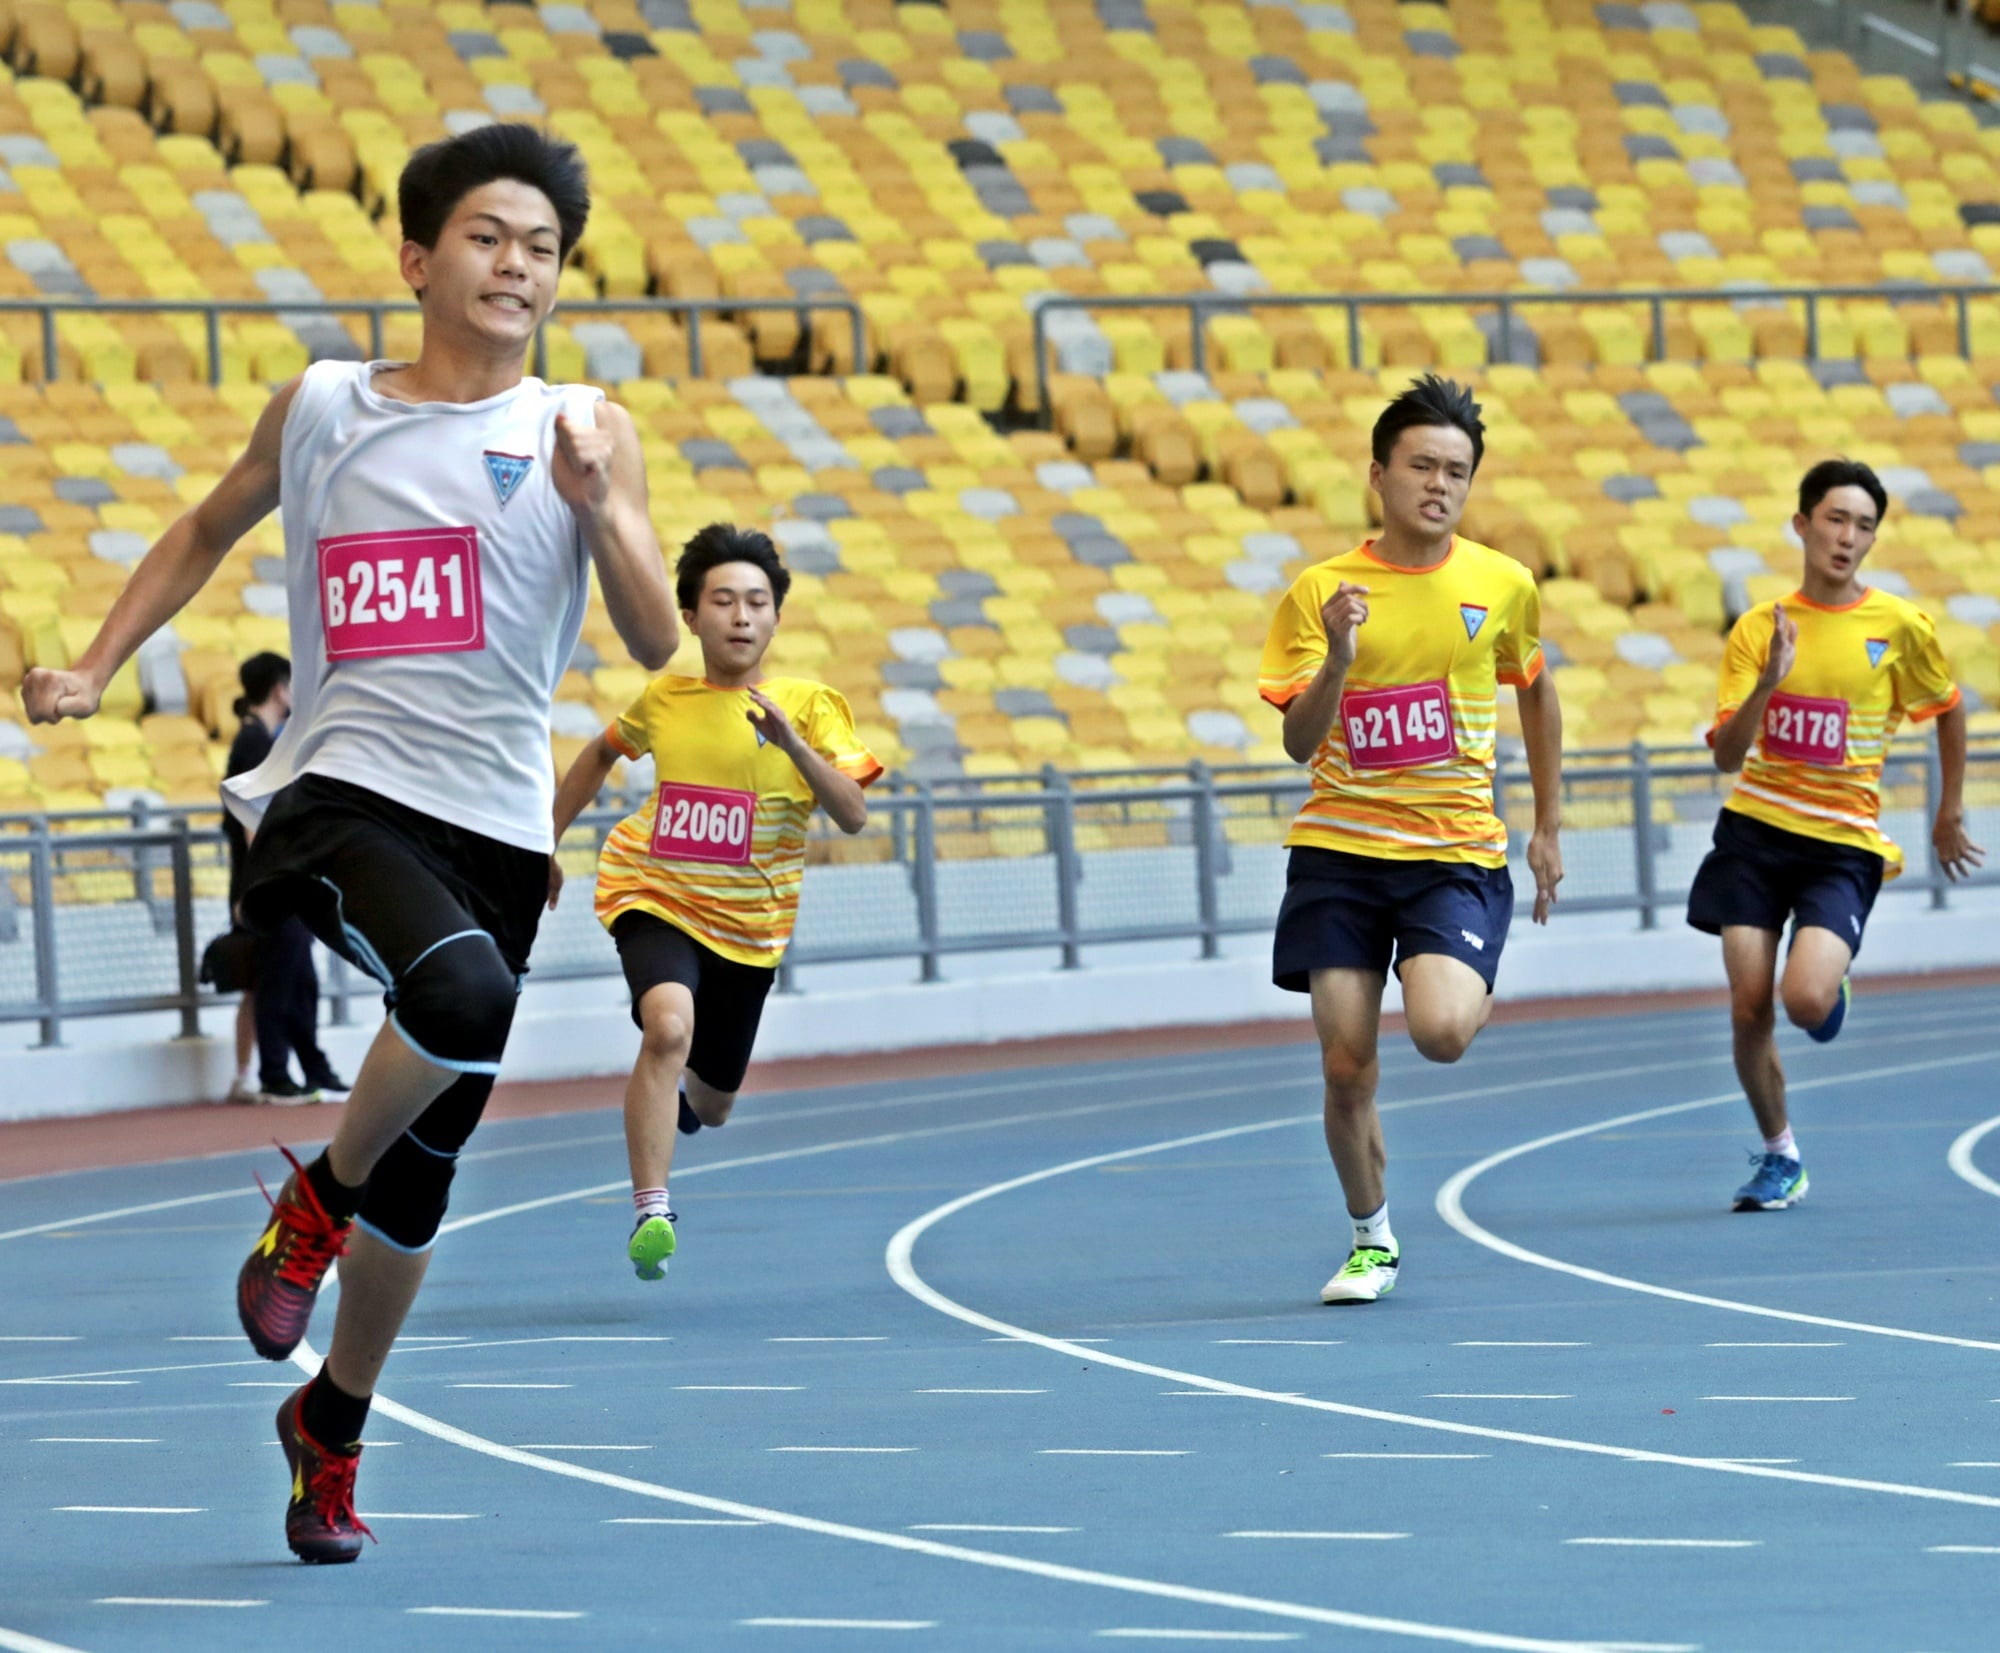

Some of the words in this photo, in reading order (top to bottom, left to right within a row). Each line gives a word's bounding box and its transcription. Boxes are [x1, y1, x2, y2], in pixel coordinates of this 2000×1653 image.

[326, 554, 465, 627] B2541
[1348, 698, 1446, 749] B2145
[1768, 706, 1840, 749] B2178
[658, 799, 746, 846] B2060
